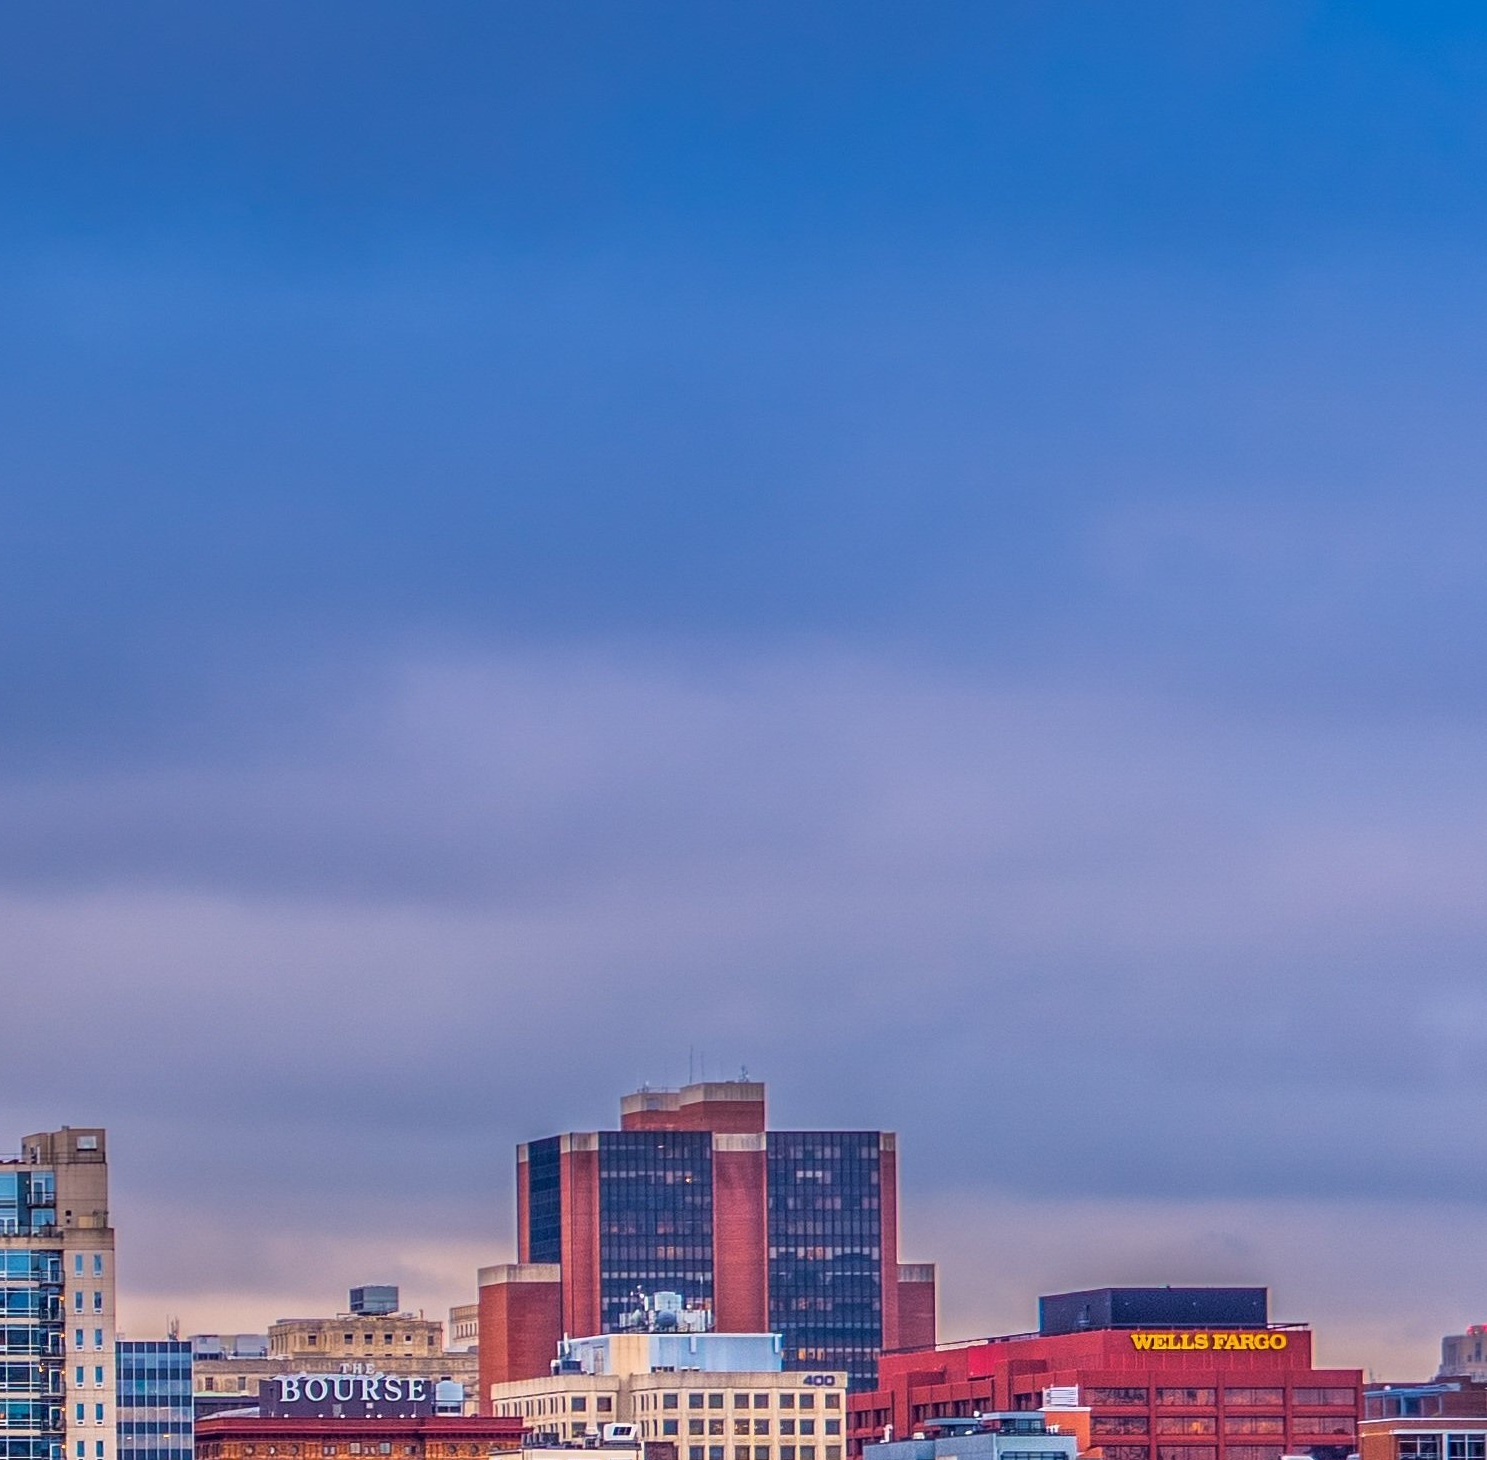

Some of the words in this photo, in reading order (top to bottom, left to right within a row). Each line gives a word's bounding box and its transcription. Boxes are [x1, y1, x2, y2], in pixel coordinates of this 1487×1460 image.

[1130, 1334, 1209, 1350] WELLS
[1212, 1334, 1287, 1350] FARGO
[340, 1363, 375, 1375] THE
[803, 1375, 835, 1386] 400
[278, 1377, 427, 1402] BOURSE
